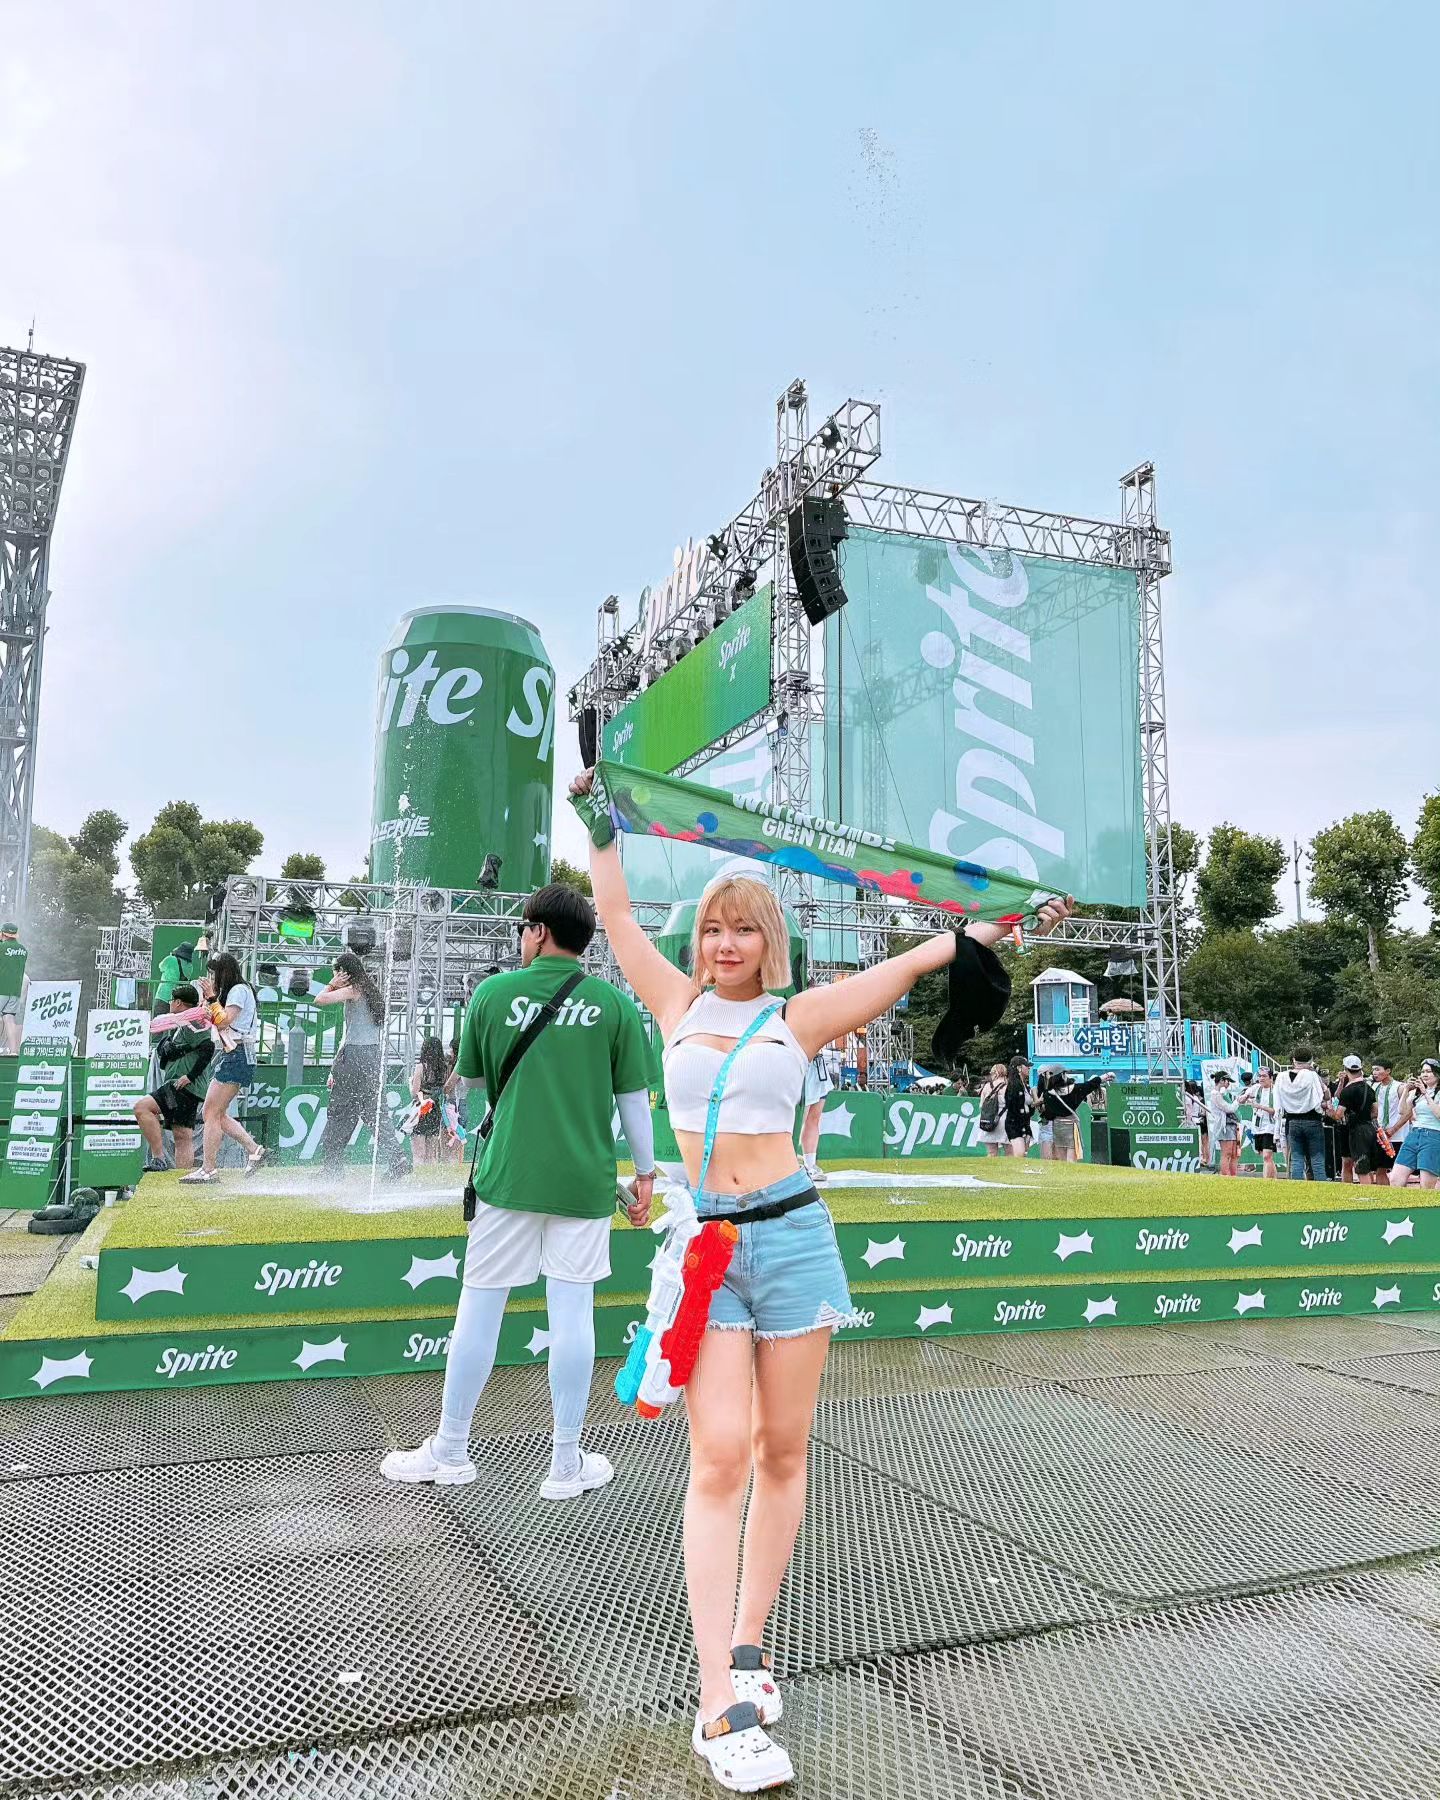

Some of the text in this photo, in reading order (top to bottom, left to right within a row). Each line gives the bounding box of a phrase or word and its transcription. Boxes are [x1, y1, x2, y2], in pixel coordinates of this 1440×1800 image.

[719, 624, 750, 670] Sprite
[920, 541, 1065, 880] Sprite
[613, 721, 634, 752] Sprite
[762, 817, 858, 859] GREEN TEAM
[5, 947, 27, 956] Sprite
[30, 990, 61, 1012] STAY
[40, 1000, 73, 1020] COOL
[52, 1019, 71, 1029] Sprite
[505, 996, 602, 1032] Spite
[94, 1018, 128, 1034] STAY
[106, 1025, 144, 1041] COOL
[121, 1039, 143, 1048] Sprite
[1076, 1028, 1129, 1053] 상쾌환
[106, 1061, 127, 1069] 가이드
[248, 1095, 282, 1108] OOL
[1121, 1087, 1138, 1095] ONE
[952, 1221, 1349, 1261] Sprite Sprite Sprite
[254, 1259, 343, 1296] Sprite
[155, 1344, 238, 1379] Sprite
[403, 1333, 453, 1362] Spri
[993, 1299, 1047, 1325] Sprite
[1154, 1293, 1201, 1318] Sprite
[1299, 1288, 1342, 1311] Sprite
